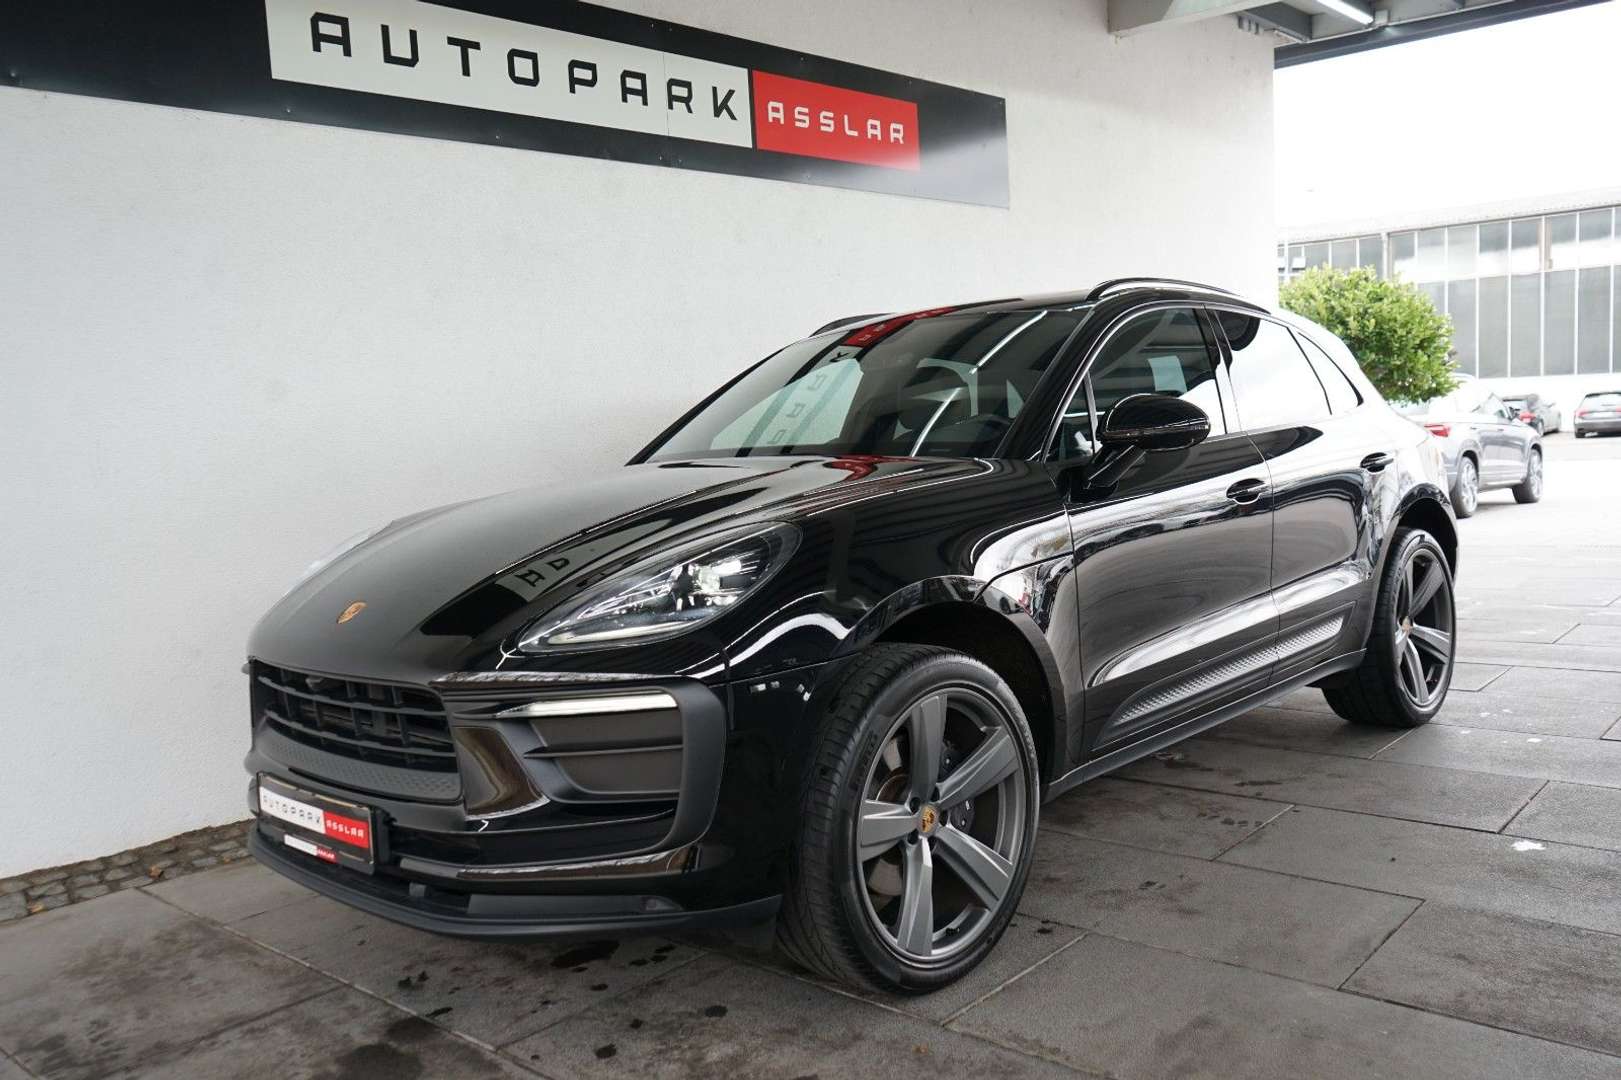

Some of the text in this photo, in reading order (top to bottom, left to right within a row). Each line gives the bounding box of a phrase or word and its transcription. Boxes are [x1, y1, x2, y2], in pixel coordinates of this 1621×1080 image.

[310, 11, 905, 144] AUTOPARK ASSLAR
[326, 819, 364, 838] ASSLAR
